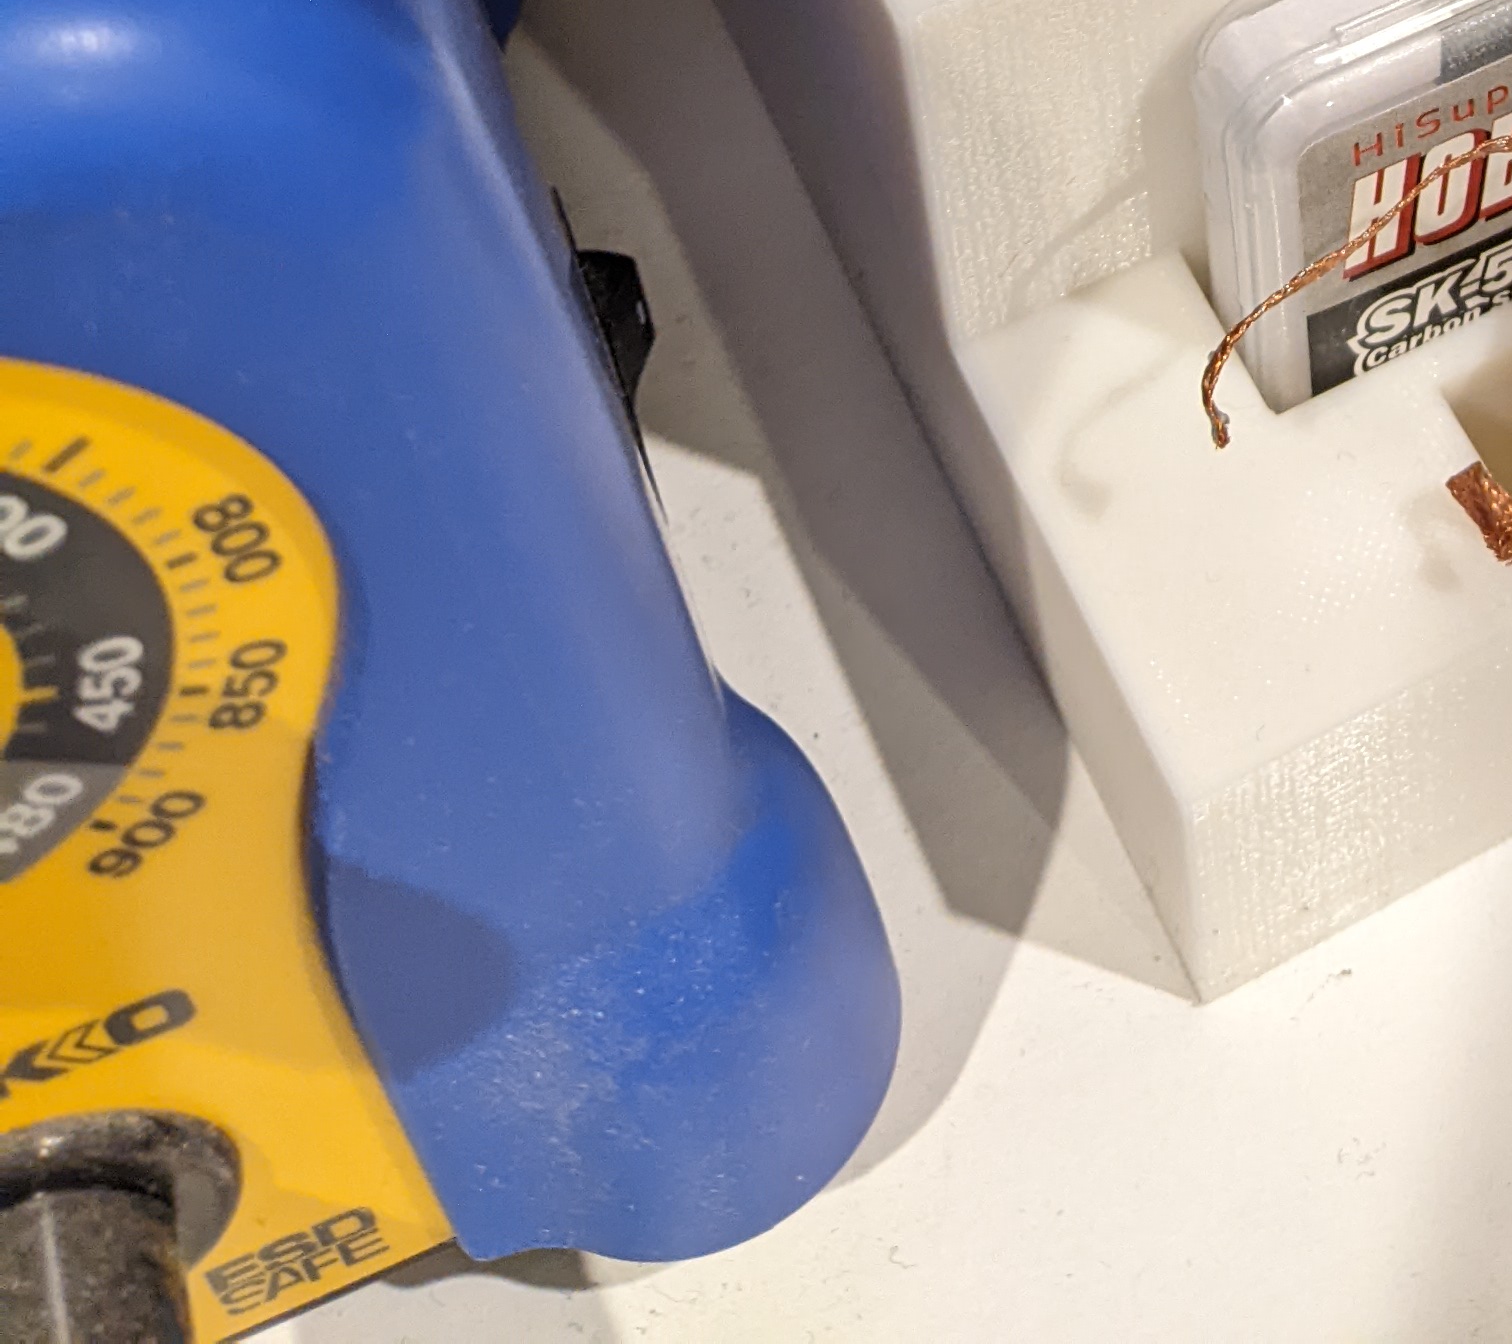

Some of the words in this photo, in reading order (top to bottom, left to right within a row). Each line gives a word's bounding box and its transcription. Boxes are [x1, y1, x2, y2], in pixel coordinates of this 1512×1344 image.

[0, 493, 68, 562] 00
[192, 492, 284, 585] 800
[72, 633, 146, 734] 450
[207, 637, 289, 734] 850
[0, 771, 85, 858] 80
[86, 787, 207, 880] 900
[204, 1205, 379, 1296] ESD
[219, 1226, 392, 1318] SAFE
